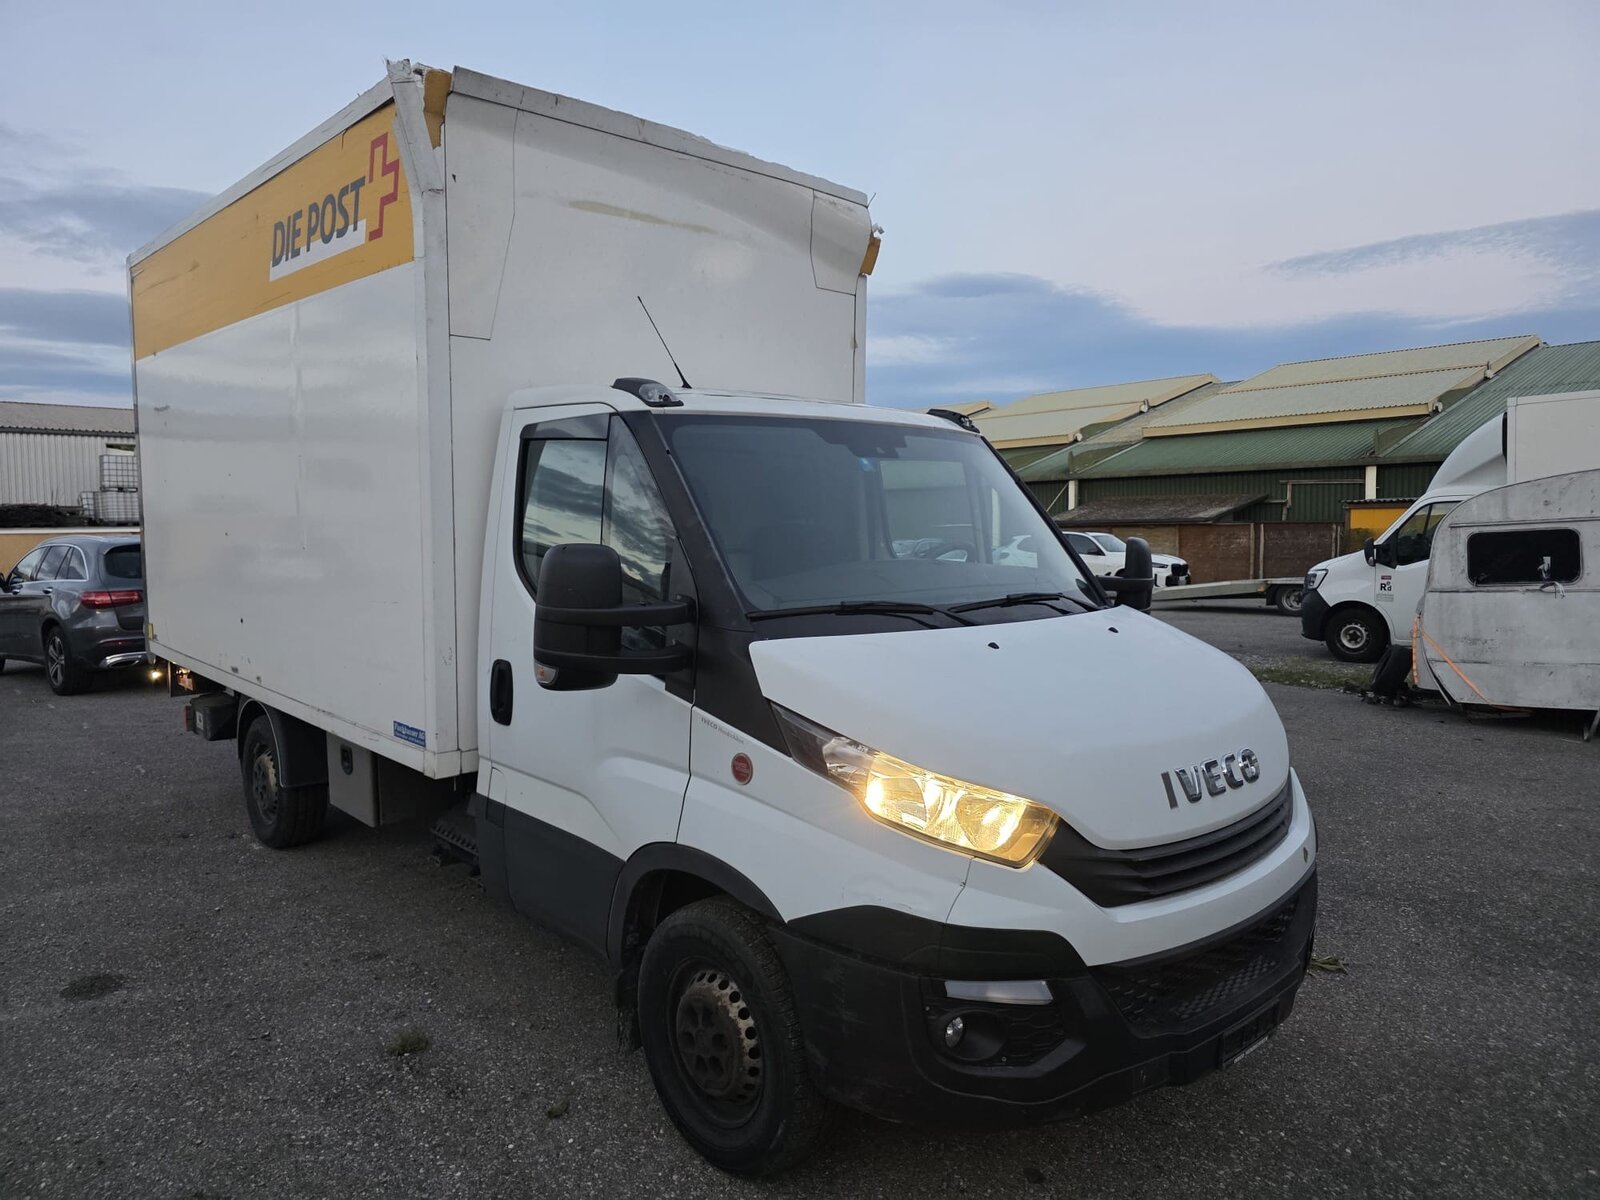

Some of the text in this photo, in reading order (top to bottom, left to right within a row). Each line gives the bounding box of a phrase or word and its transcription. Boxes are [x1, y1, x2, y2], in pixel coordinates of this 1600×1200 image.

[271, 175, 366, 268] DIE POST
[1160, 747, 1261, 810] IVECO
